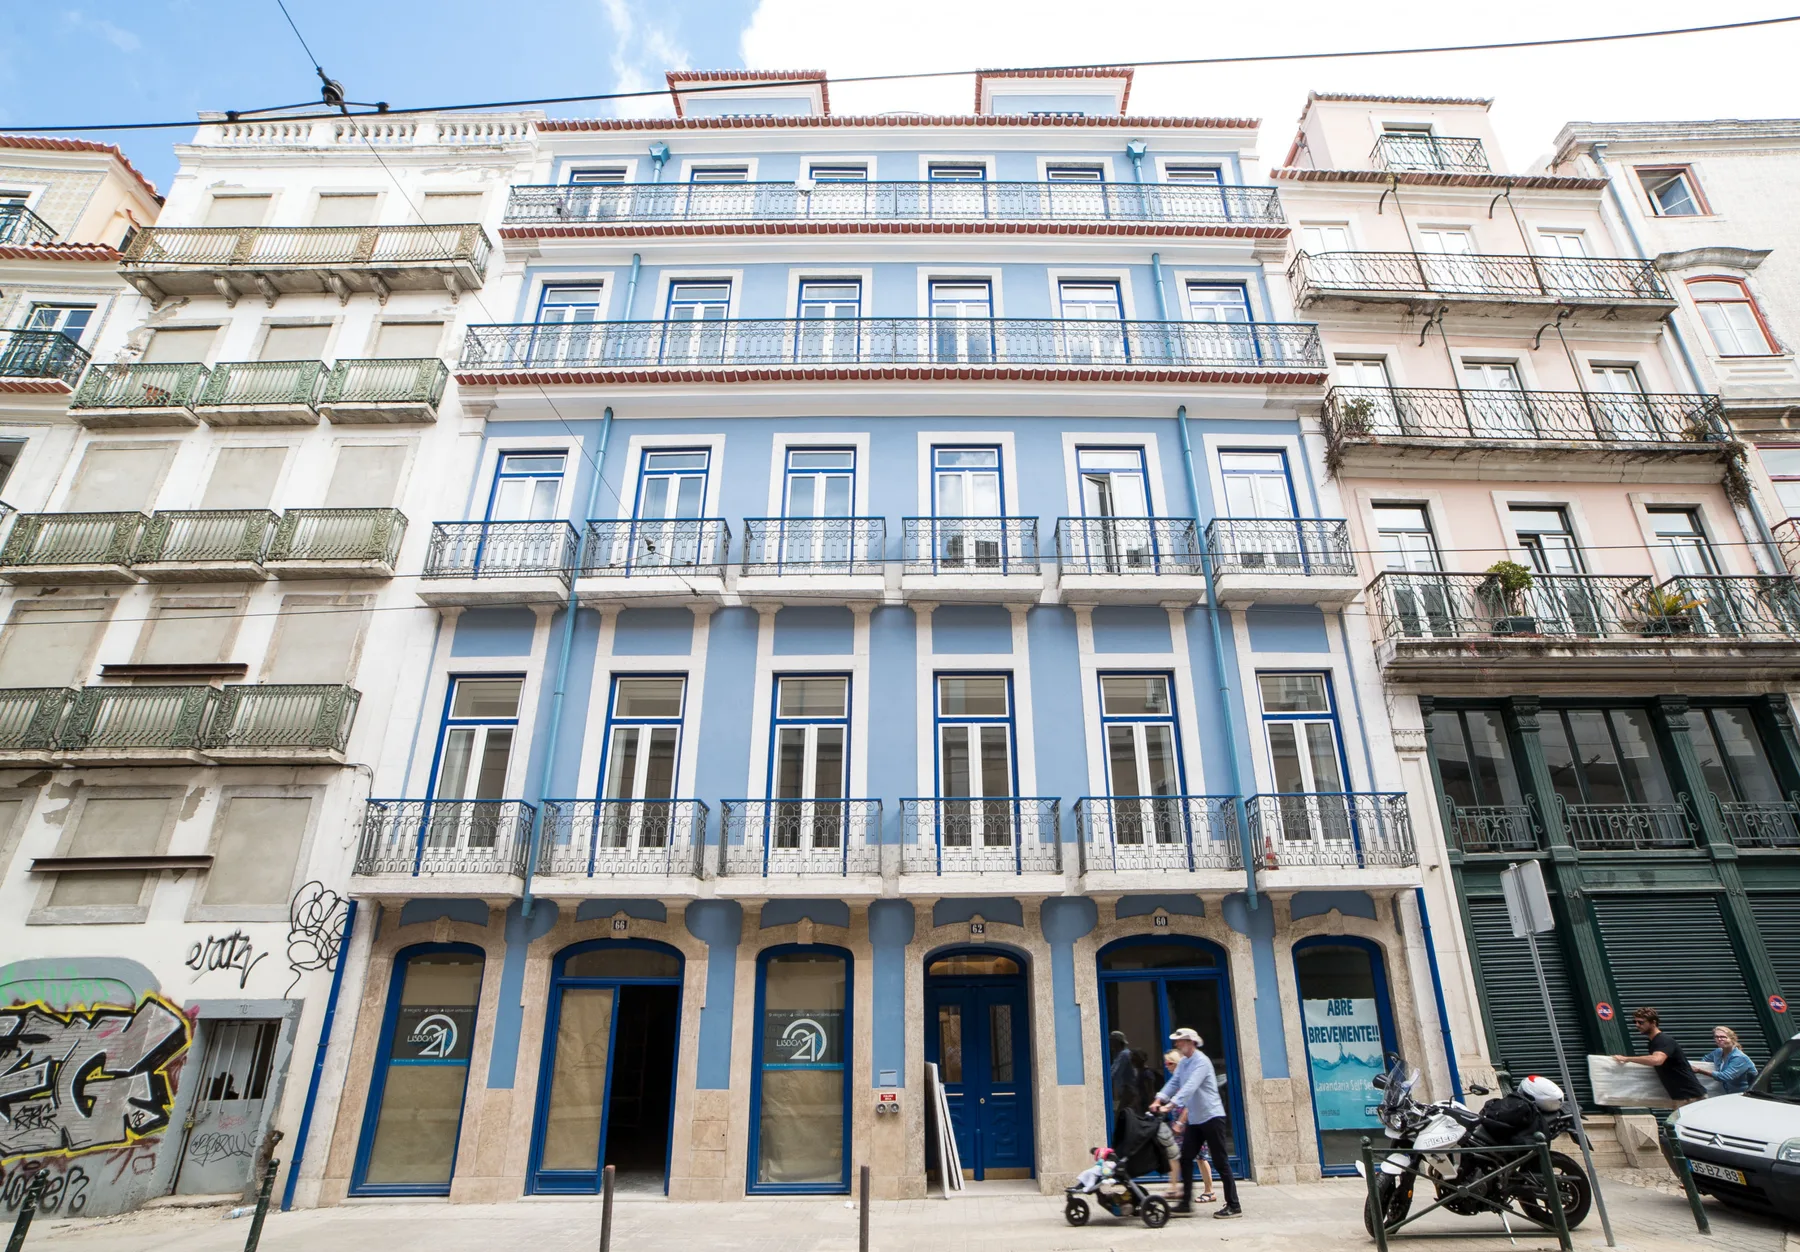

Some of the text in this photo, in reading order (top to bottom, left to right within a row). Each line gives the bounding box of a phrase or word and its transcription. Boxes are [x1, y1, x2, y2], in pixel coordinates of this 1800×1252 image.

[615, 920, 625, 930] 66
[1156, 917, 1165, 925] 60
[972, 924, 983, 933] 62
[1327, 999, 1353, 1016] ABRE
[407, 1034, 433, 1043] LISBOA
[1308, 1025, 1379, 1043] BREVEMENTE!!
[776, 1039, 802, 1047] LISBOA
[1316, 1079, 1374, 1091] Lavandaria Self Ser
[1423, 1131, 1458, 1148] TIGER
